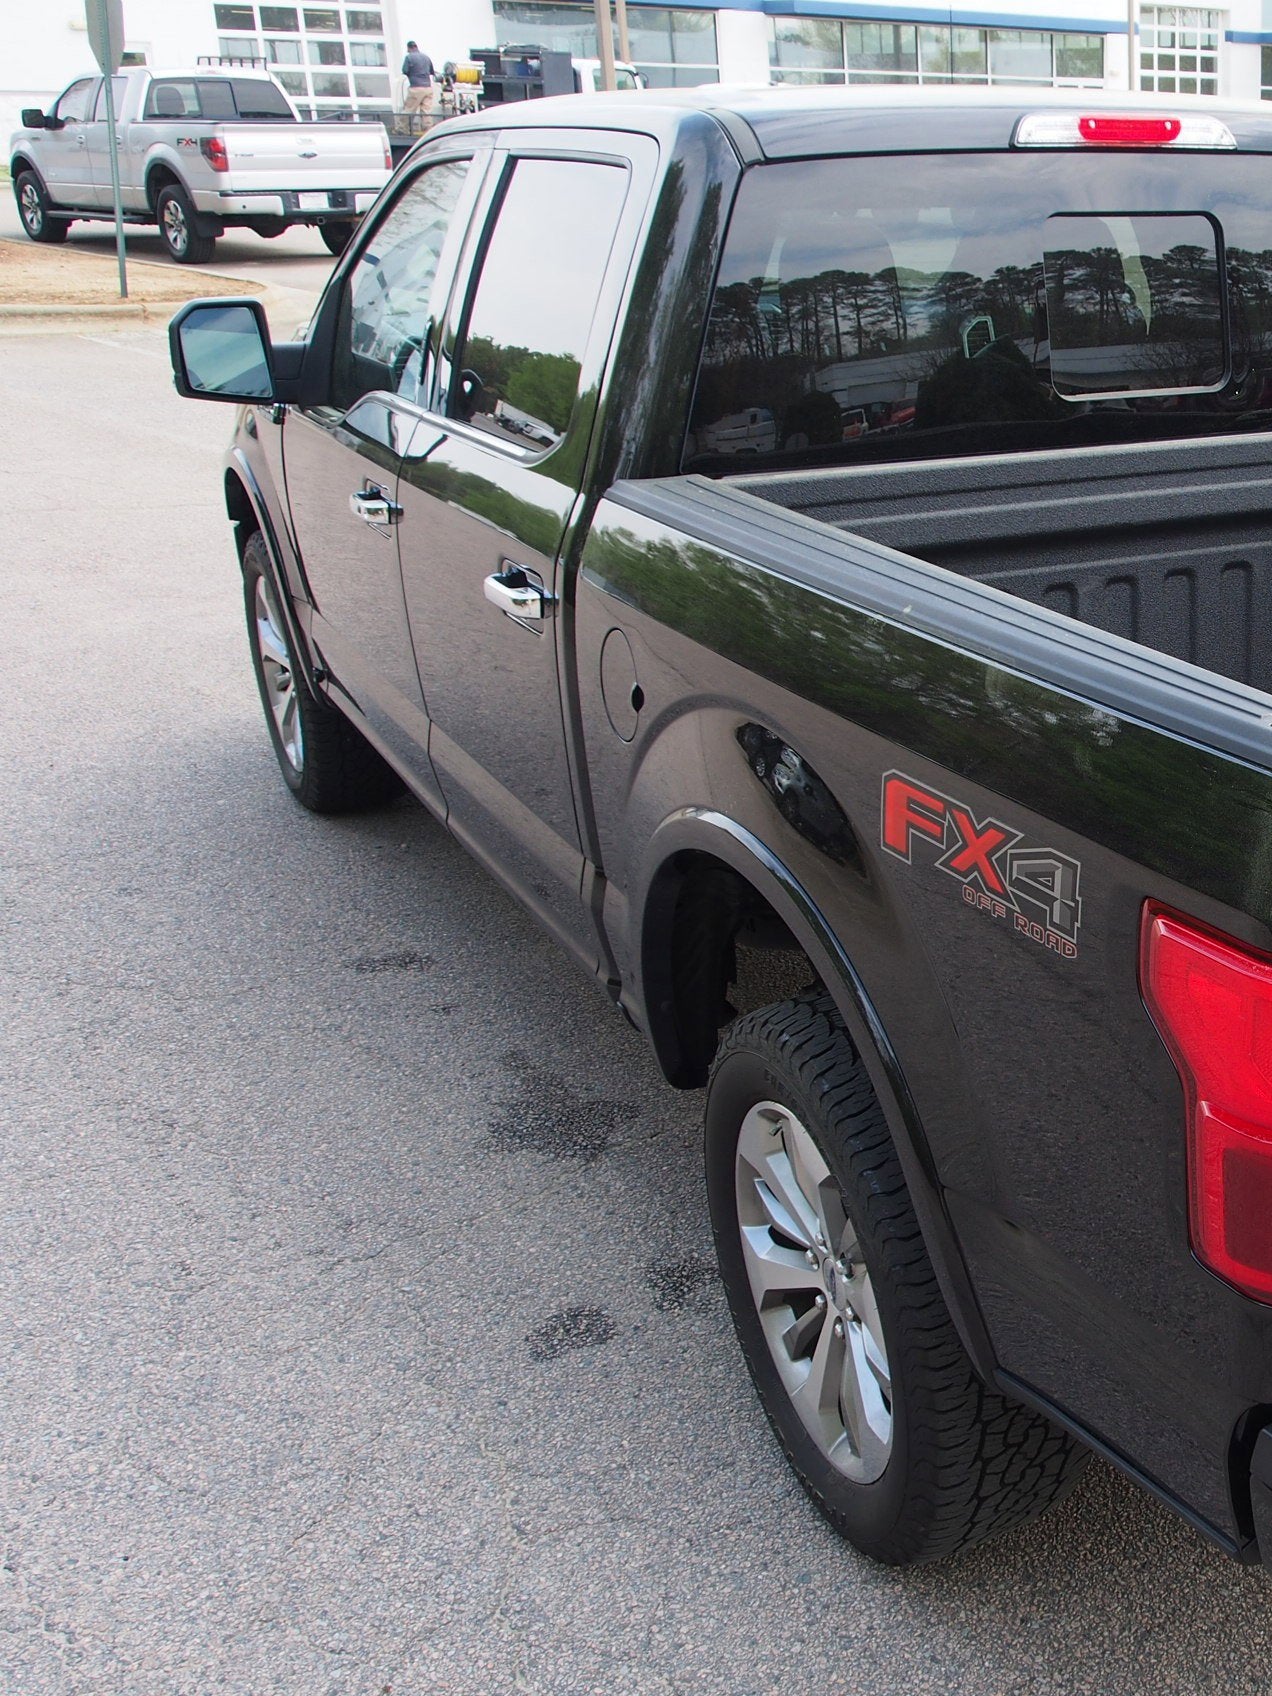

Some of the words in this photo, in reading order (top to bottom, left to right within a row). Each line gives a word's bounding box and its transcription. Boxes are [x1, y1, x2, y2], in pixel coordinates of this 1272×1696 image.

[177, 138, 198, 146] FX4
[881, 769, 1081, 943] FX4
[962, 884, 1006, 918] OFF
[1014, 912, 1078, 959] ROAD
